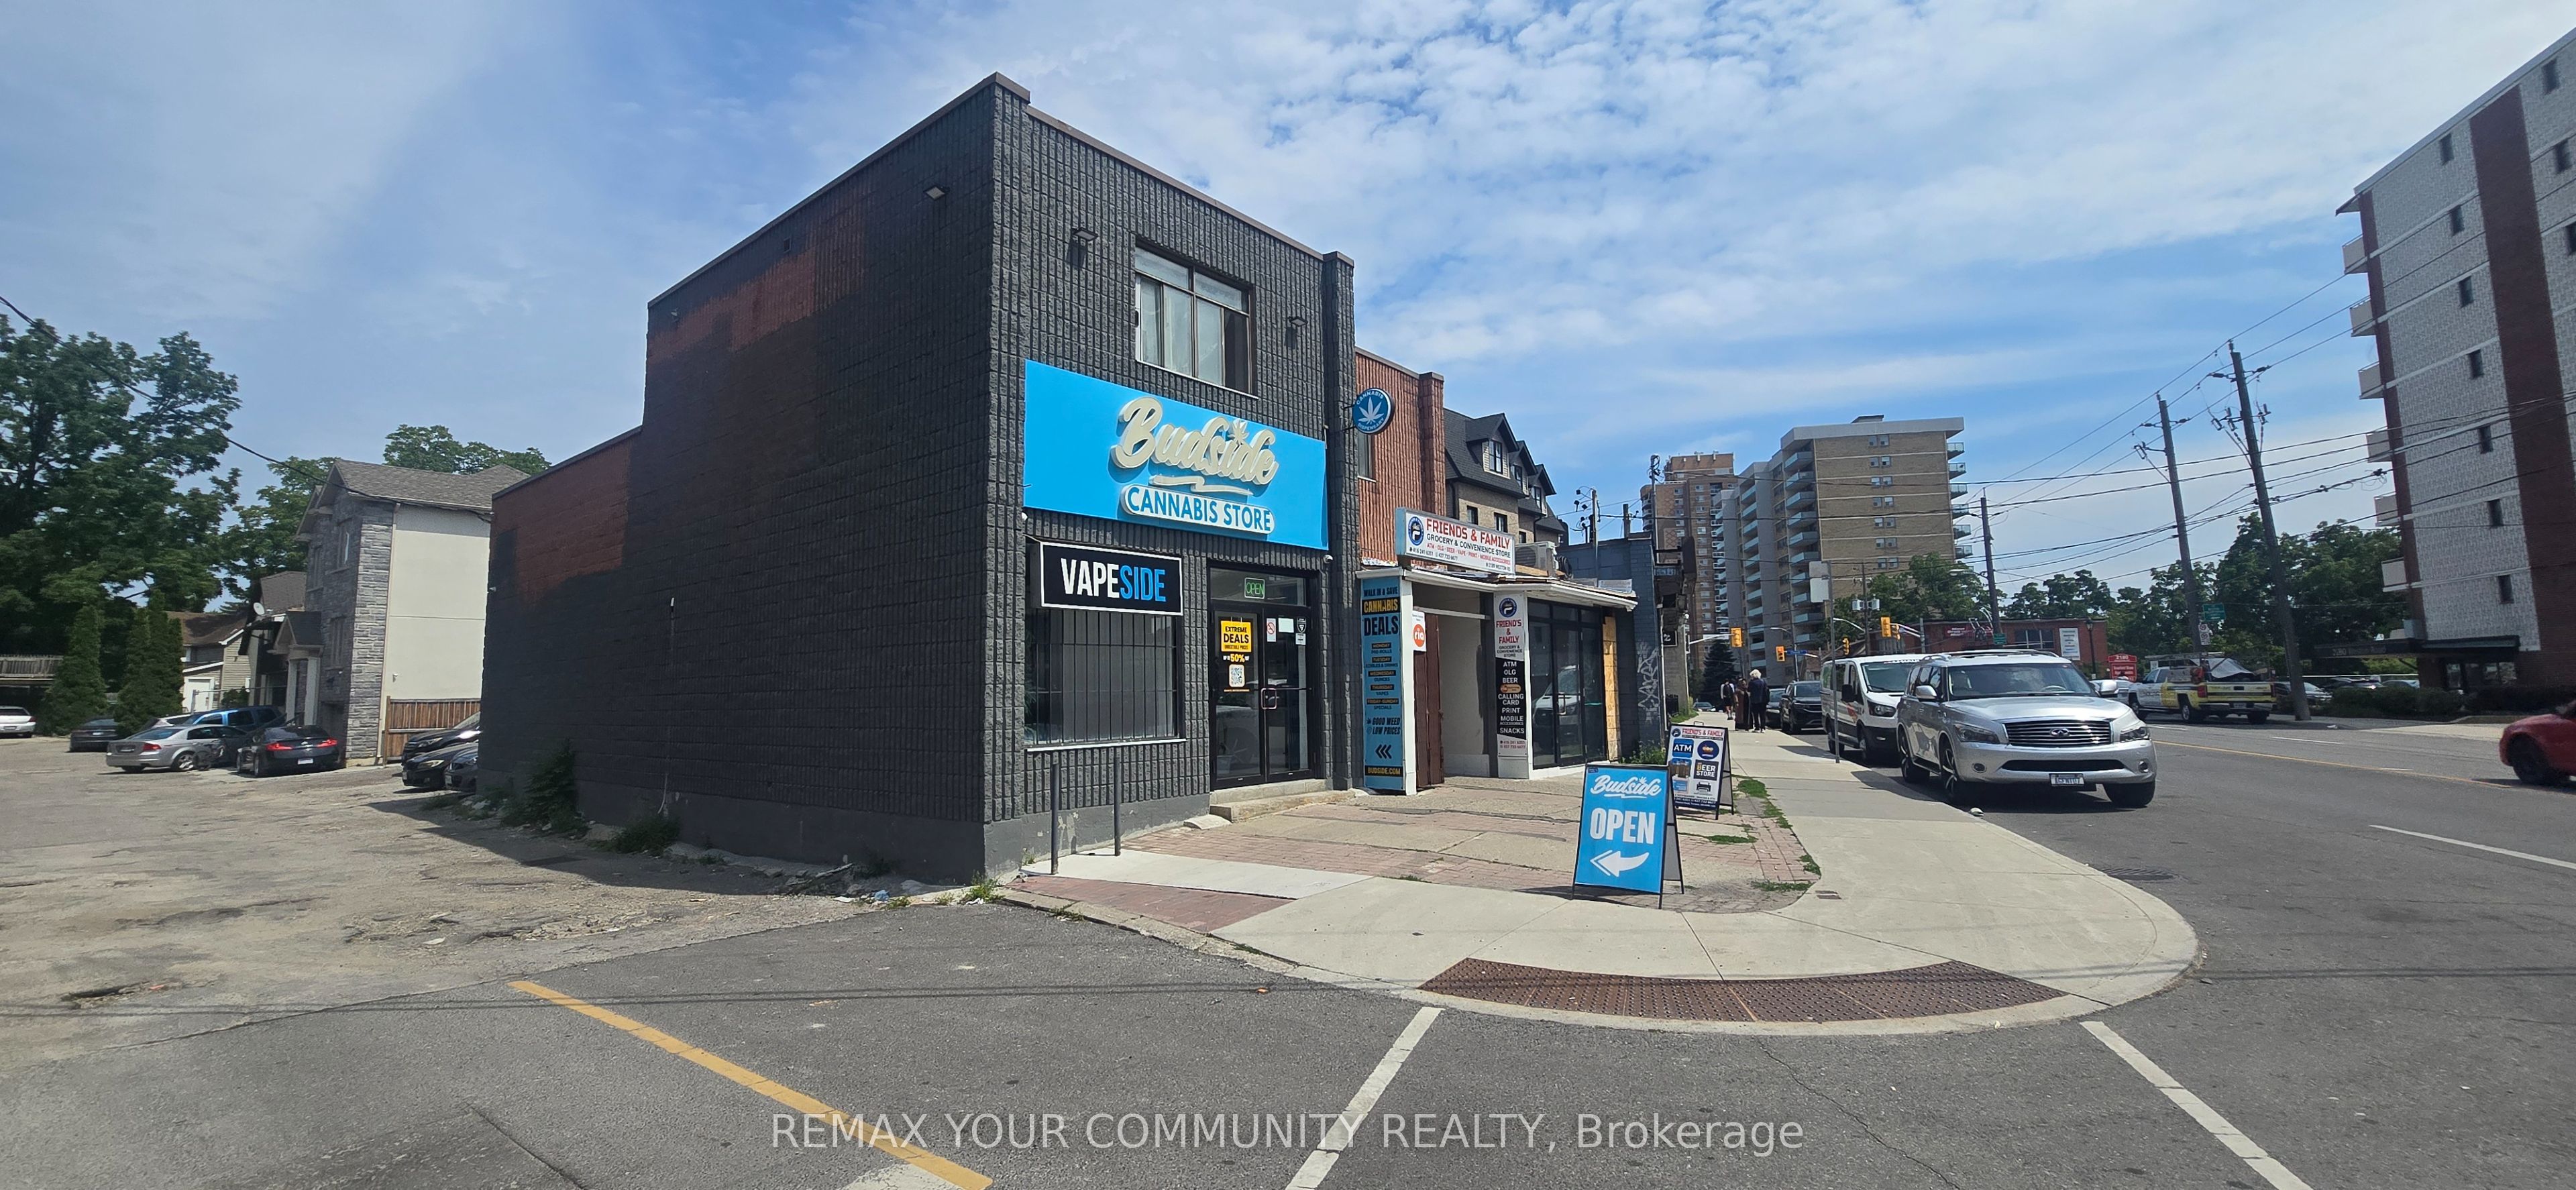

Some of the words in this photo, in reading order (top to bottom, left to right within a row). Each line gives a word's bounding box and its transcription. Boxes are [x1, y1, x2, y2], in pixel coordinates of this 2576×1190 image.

[1356, 391, 1384, 404] CANNABIS
[1110, 396, 1279, 486] Budside
[1127, 486, 1218, 523] CANNABIS
[1223, 504, 1271, 531] STORE
[1426, 518, 1467, 539] FRIENDS
[1470, 529, 1477, 541] &
[1480, 531, 1510, 549] FAMILY
[1427, 533, 1454, 545] GROCERY
[1460, 541, 1495, 554] CONVENIENCE
[1495, 549, 1511, 559] STORE
[1060, 557, 1167, 602] VAPESIDE
[1246, 582, 1264, 596] OPEN
[1363, 588, 1375, 597] WALK
[1377, 588, 1381, 596] IN
[1387, 586, 1398, 595] SAVE
[1364, 598, 1399, 613] CANNABIS
[1364, 615, 1399, 637] DEALS
[1496, 619, 1522, 628] FRIEND'S
[1223, 633, 1249, 644] DEALS
[1415, 627, 1424, 641] ria
[1499, 636, 1519, 644] FAMILY
[1230, 653, 1245, 663] 50%
[1372, 717, 1385, 725] GOOD
[1387, 717, 1401, 725] WEED
[1372, 726, 1382, 735] LOW
[1383, 726, 1401, 735] PRICES
[1674, 744, 1692, 752] ATM
[1367, 767, 1401, 775] BUDSIDE.COM
[1697, 763, 1716, 771] BEER
[1590, 774, 1662, 796] Budside
[1589, 807, 1656, 845] OPEN
